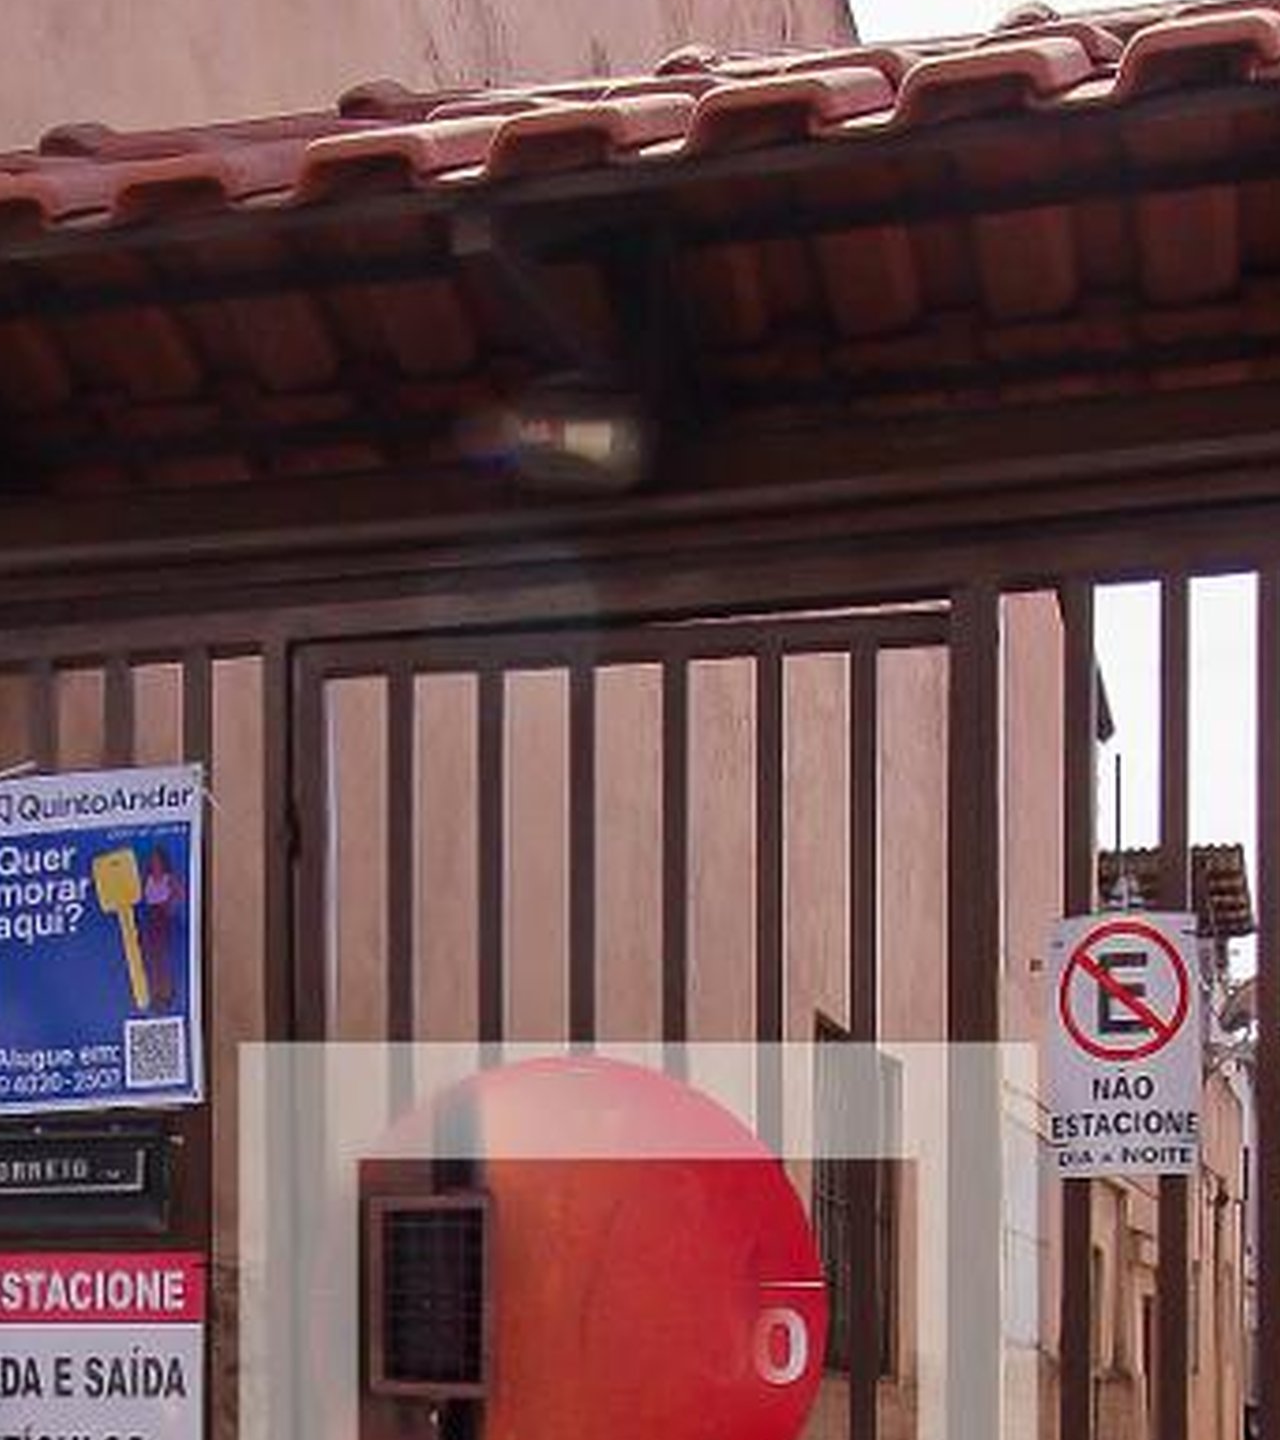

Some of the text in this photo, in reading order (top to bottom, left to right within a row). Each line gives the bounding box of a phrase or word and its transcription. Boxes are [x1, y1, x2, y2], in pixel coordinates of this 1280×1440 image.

[19, 785, 193, 821] QuintoAndar
[1091, 1067, 1155, 1101] NÃO
[1051, 1111, 1199, 1140] ESTACIONE
[1122, 1146, 1193, 1165] NOITE
[54, 1358, 74, 1397] E
[84, 1346, 187, 1398] SAÍDA
